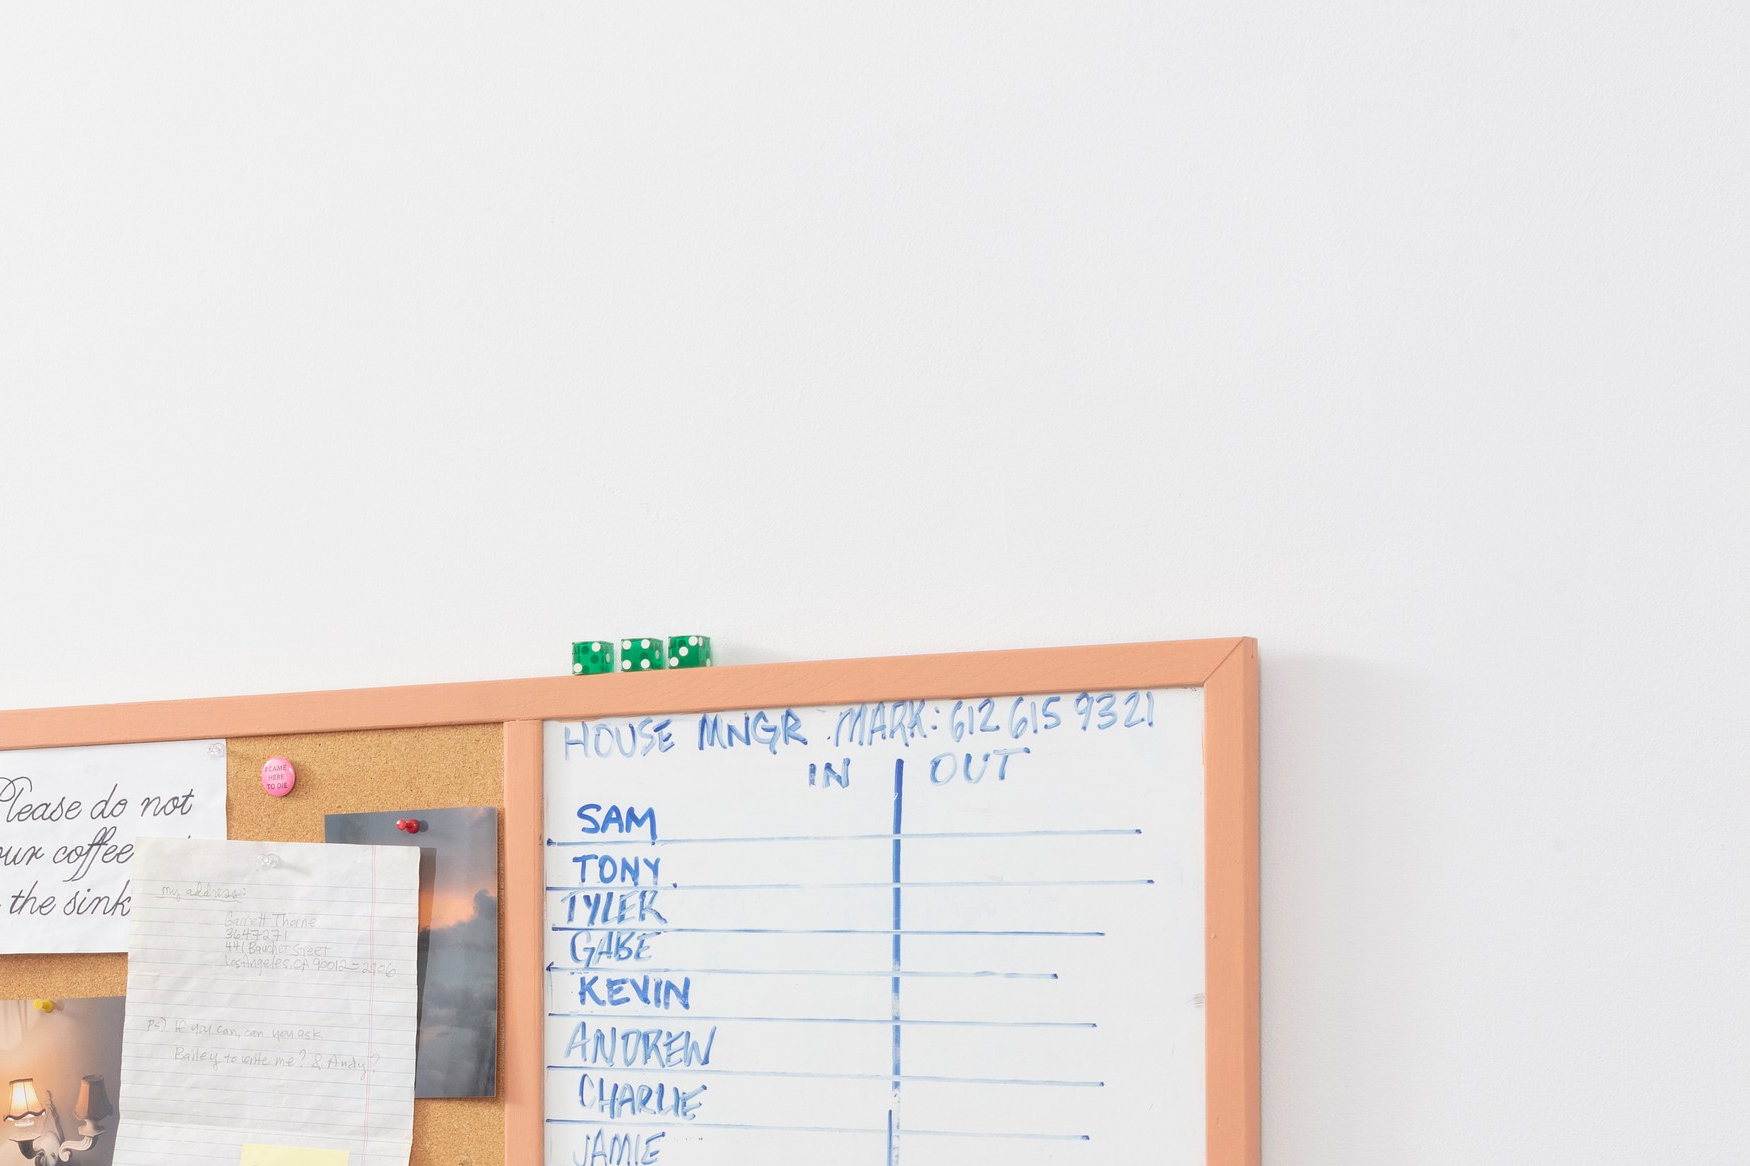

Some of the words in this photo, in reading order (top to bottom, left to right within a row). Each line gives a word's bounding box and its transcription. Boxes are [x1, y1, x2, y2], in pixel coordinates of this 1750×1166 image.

[564, 717, 675, 760] HOUSE
[698, 709, 808, 754] MNGR
[949, 697, 1000, 743] 612
[1008, 695, 1061, 738] 615
[1077, 691, 1154, 732] 9321
[808, 757, 850, 789] IN
[930, 746, 1031, 786] OUT
[90, 784, 128, 820] do
[141, 788, 193, 817] not
[576, 803, 658, 844] SAM
[52, 826, 134, 882] coffee
[572, 854, 662, 886] TONY
[9, 880, 56, 916] the
[63, 879, 131, 917] sink
[162, 885, 181, 901] my
[185, 881, 246, 898] address:
[561, 889, 667, 927] TYLER
[225, 929, 288, 941] 3647271
[225, 941, 244, 953] 441
[570, 930, 662, 965] GABE
[577, 973, 691, 1010] KEVIN
[191, 1024, 212, 1037] you
[244, 1028, 264, 1038] can
[271, 1029, 294, 1042] you
[296, 1028, 324, 1040] ask
[564, 1026, 717, 1067] ANDREW
[174, 1047, 219, 1071] Bailey
[224, 1051, 237, 1064] to
[274, 1049, 306, 1069] me?
[311, 1053, 323, 1071] &
[327, 1053, 380, 1080] Andy?
[578, 1073, 708, 1120] CHARLIE
